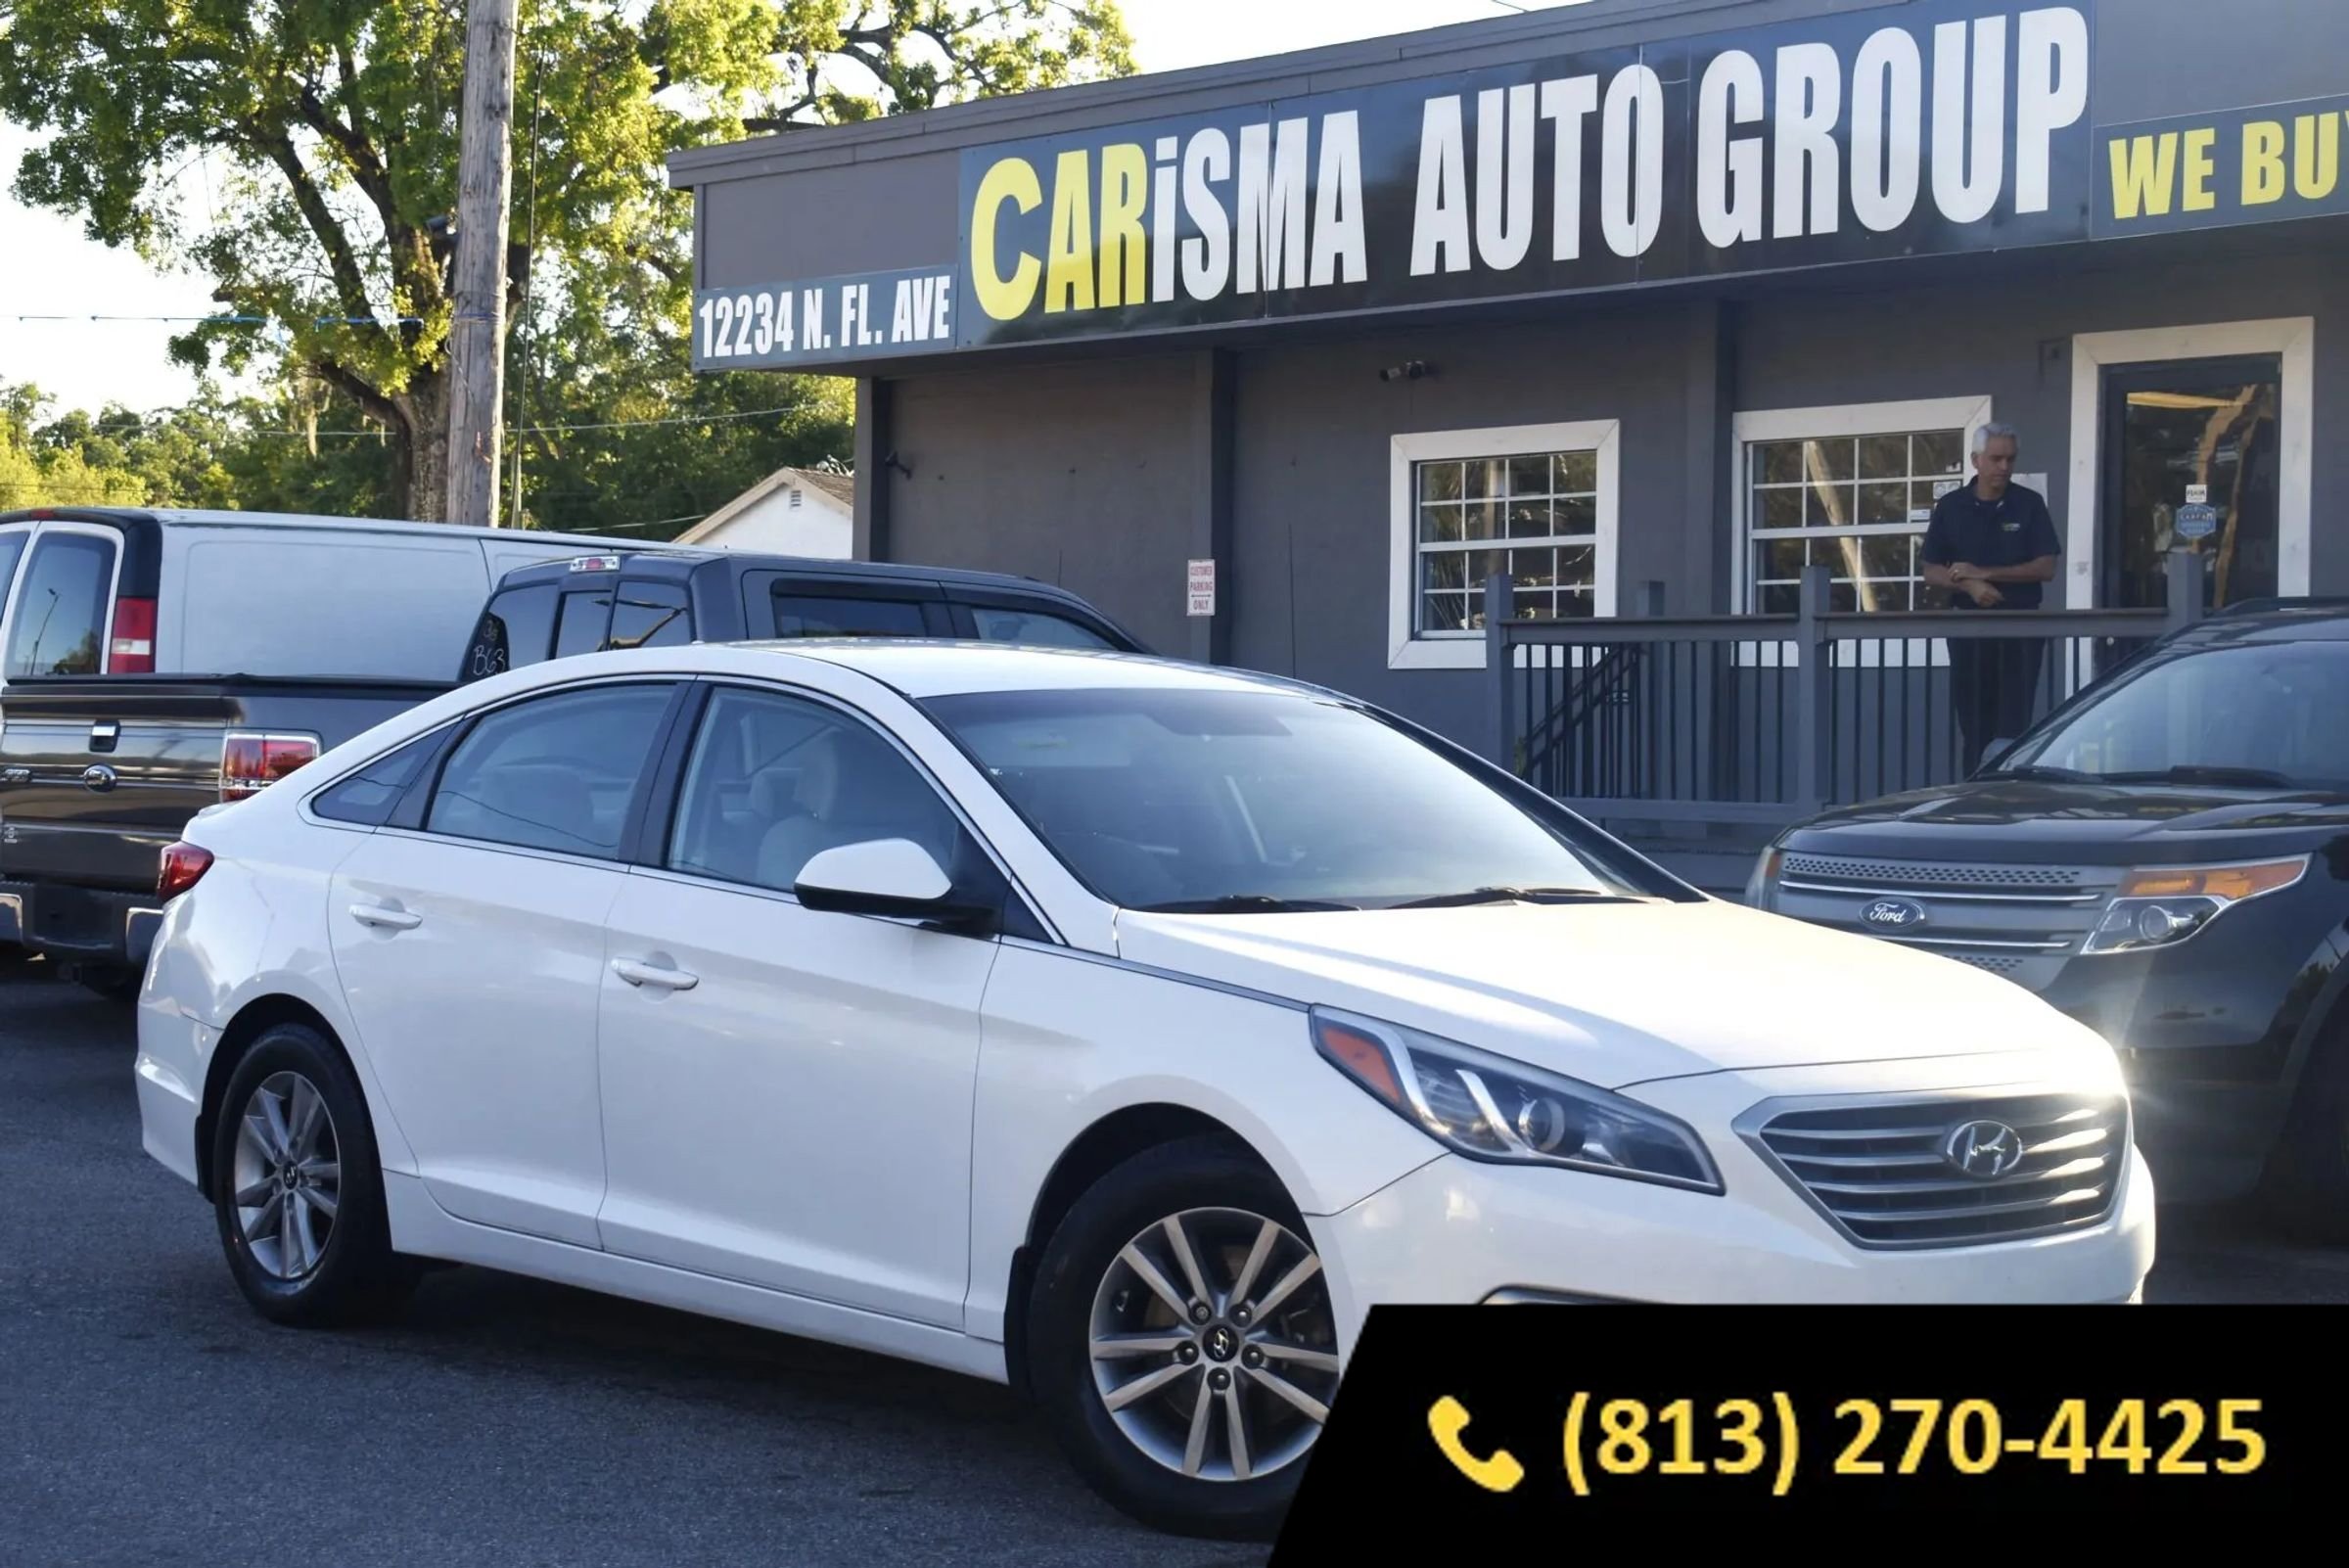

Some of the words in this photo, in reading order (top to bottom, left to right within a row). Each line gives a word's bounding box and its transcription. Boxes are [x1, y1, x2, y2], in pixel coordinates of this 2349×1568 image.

[1410, 65, 1664, 277] AUTO
[1697, 6, 2088, 250] GROUP
[2108, 127, 2215, 220] WE
[2240, 110, 2349, 206] BU
[699, 292, 795, 358] 12234
[803, 289, 831, 349] N.
[841, 284, 883, 346] FL.
[892, 275, 951, 343] AVE
[1189, 581, 1214, 592] PARKING
[1193, 600, 1209, 610] ONLY
[1869, 902, 1908, 923] Ford
